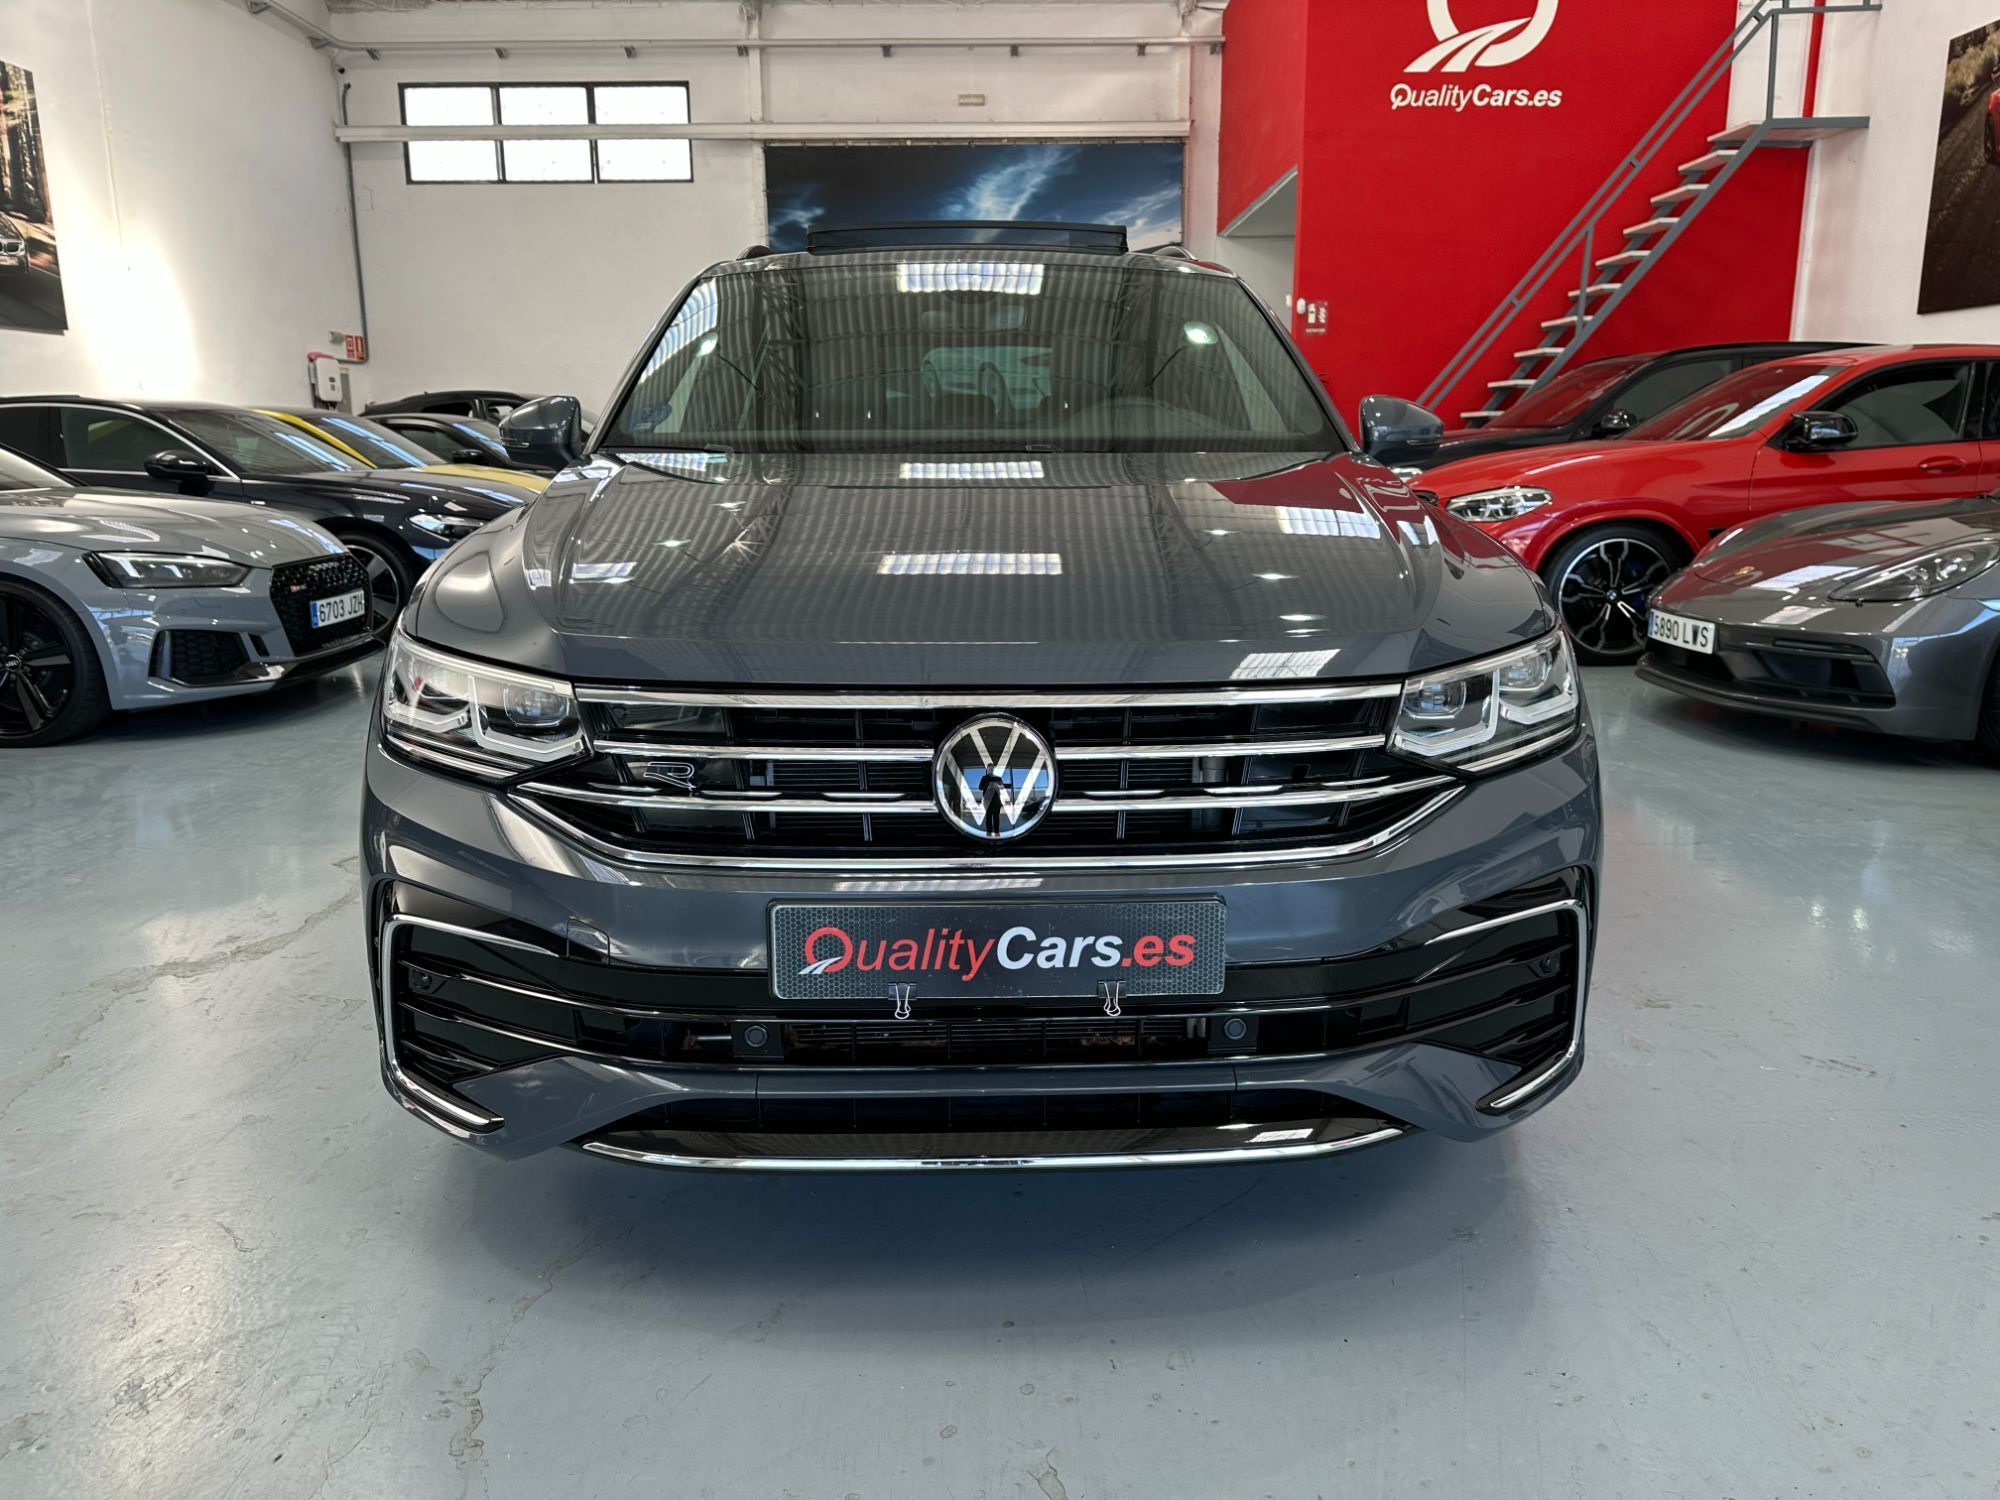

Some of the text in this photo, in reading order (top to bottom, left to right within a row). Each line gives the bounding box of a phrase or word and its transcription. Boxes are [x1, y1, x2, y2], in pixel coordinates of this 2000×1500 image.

[1390, 83, 1562, 112] QualityCars.es
[319, 599, 345, 622] 6703
[1654, 615, 1679, 641] 5890
[799, 926, 1196, 982] QualityCars.es
